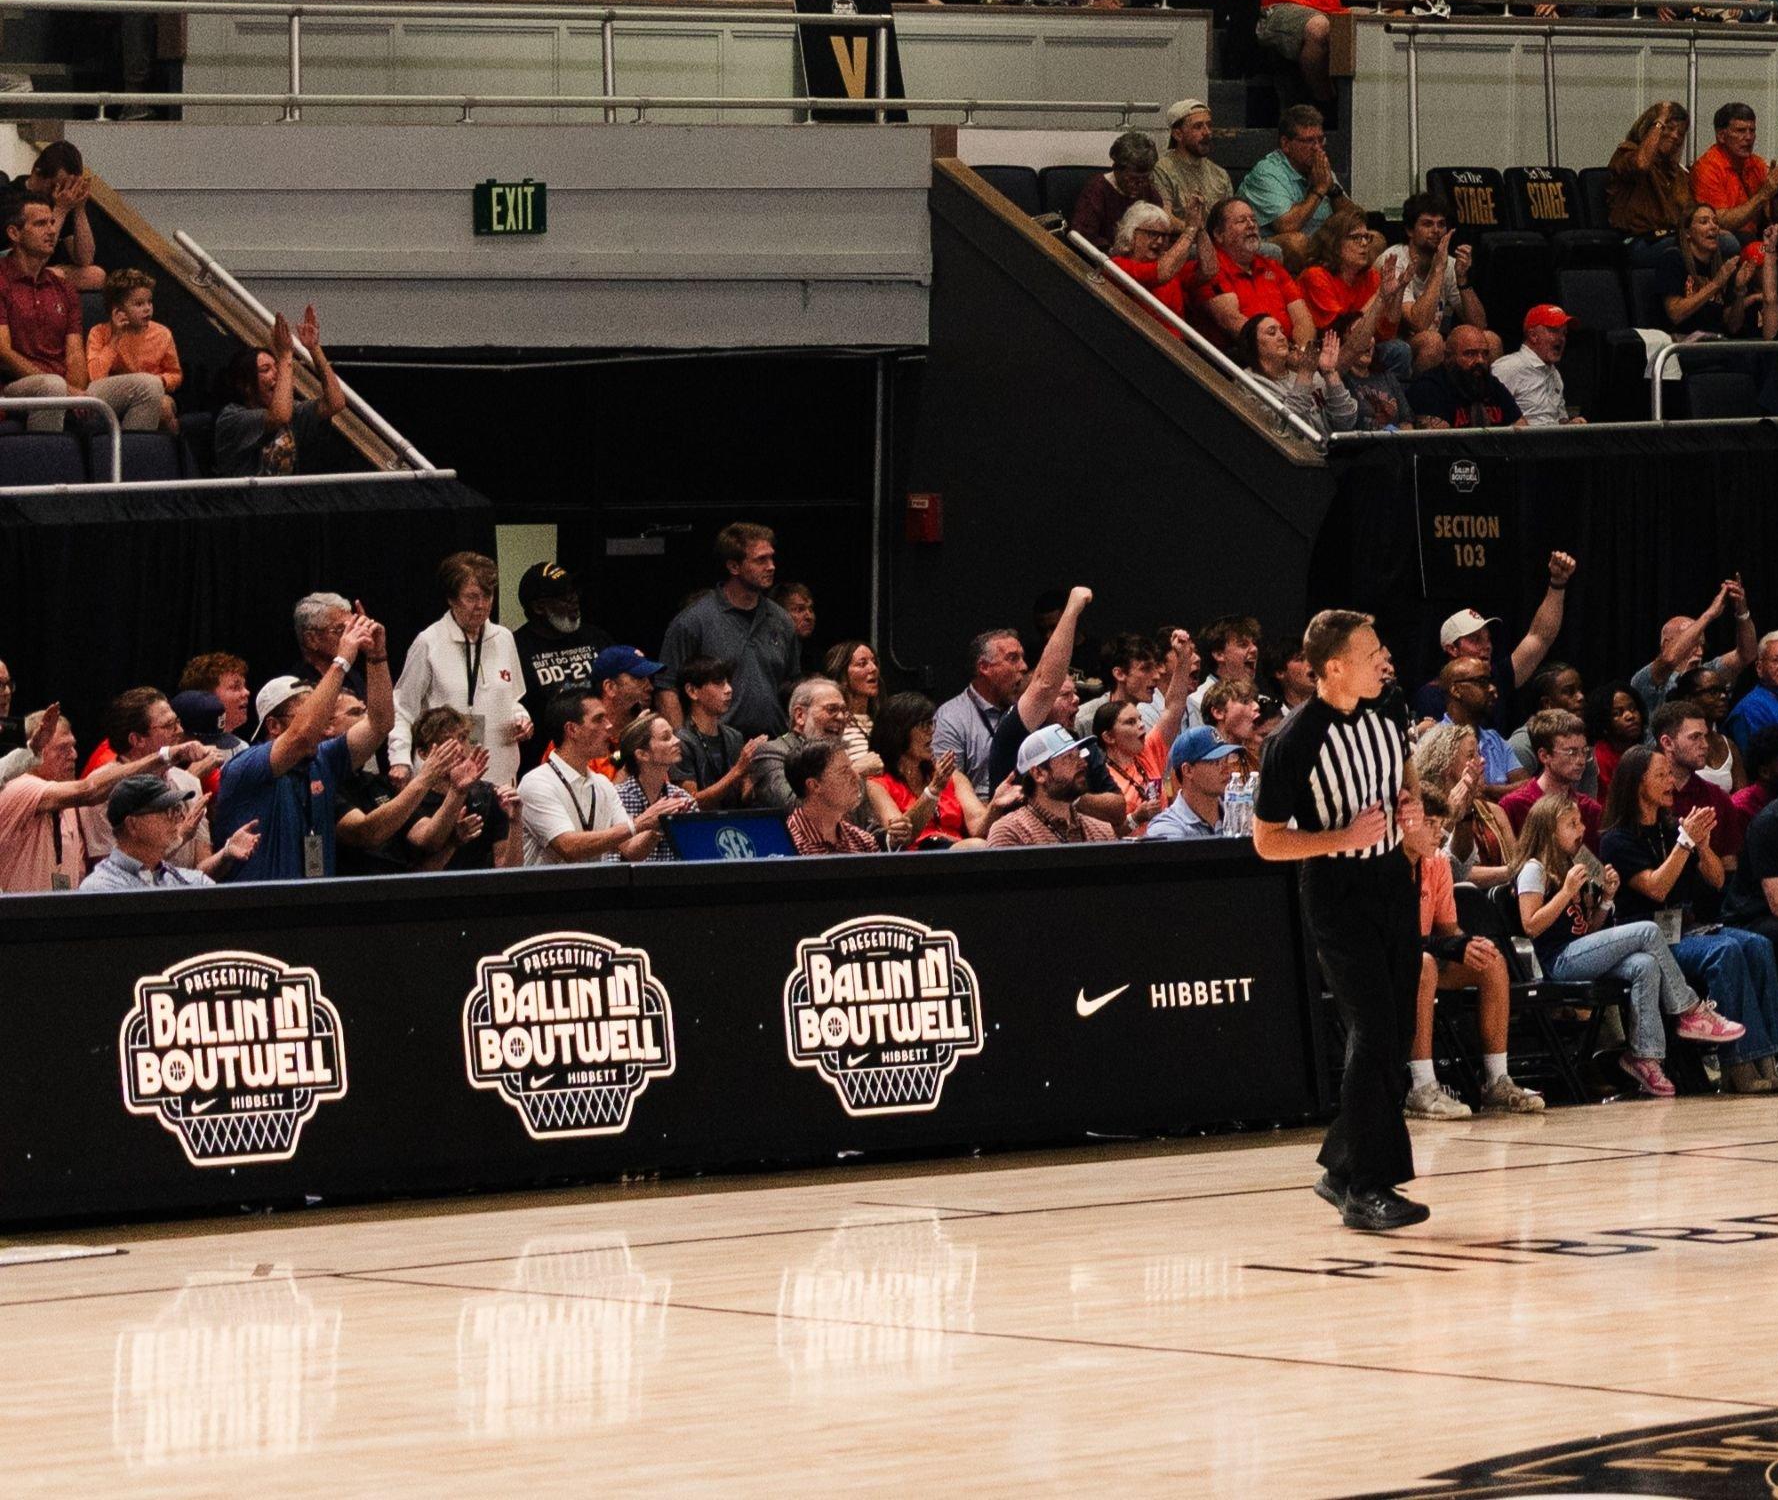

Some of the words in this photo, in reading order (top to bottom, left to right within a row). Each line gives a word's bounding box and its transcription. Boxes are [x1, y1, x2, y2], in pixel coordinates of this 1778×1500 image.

[830, 36, 868, 100] V
[491, 186, 536, 231] EXIT
[1454, 186, 1499, 225] STAGE
[1527, 182, 1570, 220] STAGE
[1433, 515, 1501, 540] SECTION
[1453, 543, 1486, 568] 103
[537, 662, 593, 686] DD-21
[524, 945, 602, 974] PRESENTING
[840, 929, 915, 957] PRESENTING
[185, 966, 270, 997] PRESENTING
[810, 953, 915, 1004] BALLIN
[920, 947, 950, 997] IN
[1150, 976, 1253, 1009] HIBBETT
[491, 971, 602, 1024] BALLIN
[608, 964, 641, 1016] IN
[150, 992, 268, 1047] BALLIN
[275, 985, 310, 1038] IN
[799, 999, 971, 1049] BOUTWELL
[479, 1018, 662, 1070] BOUTWELL
[881, 1047, 929, 1064] HIBBETT
[136, 1041, 332, 1097] BOUTWELL
[567, 1068, 618, 1085] HIBBETT
[230, 1092, 285, 1111] HIBBETT
